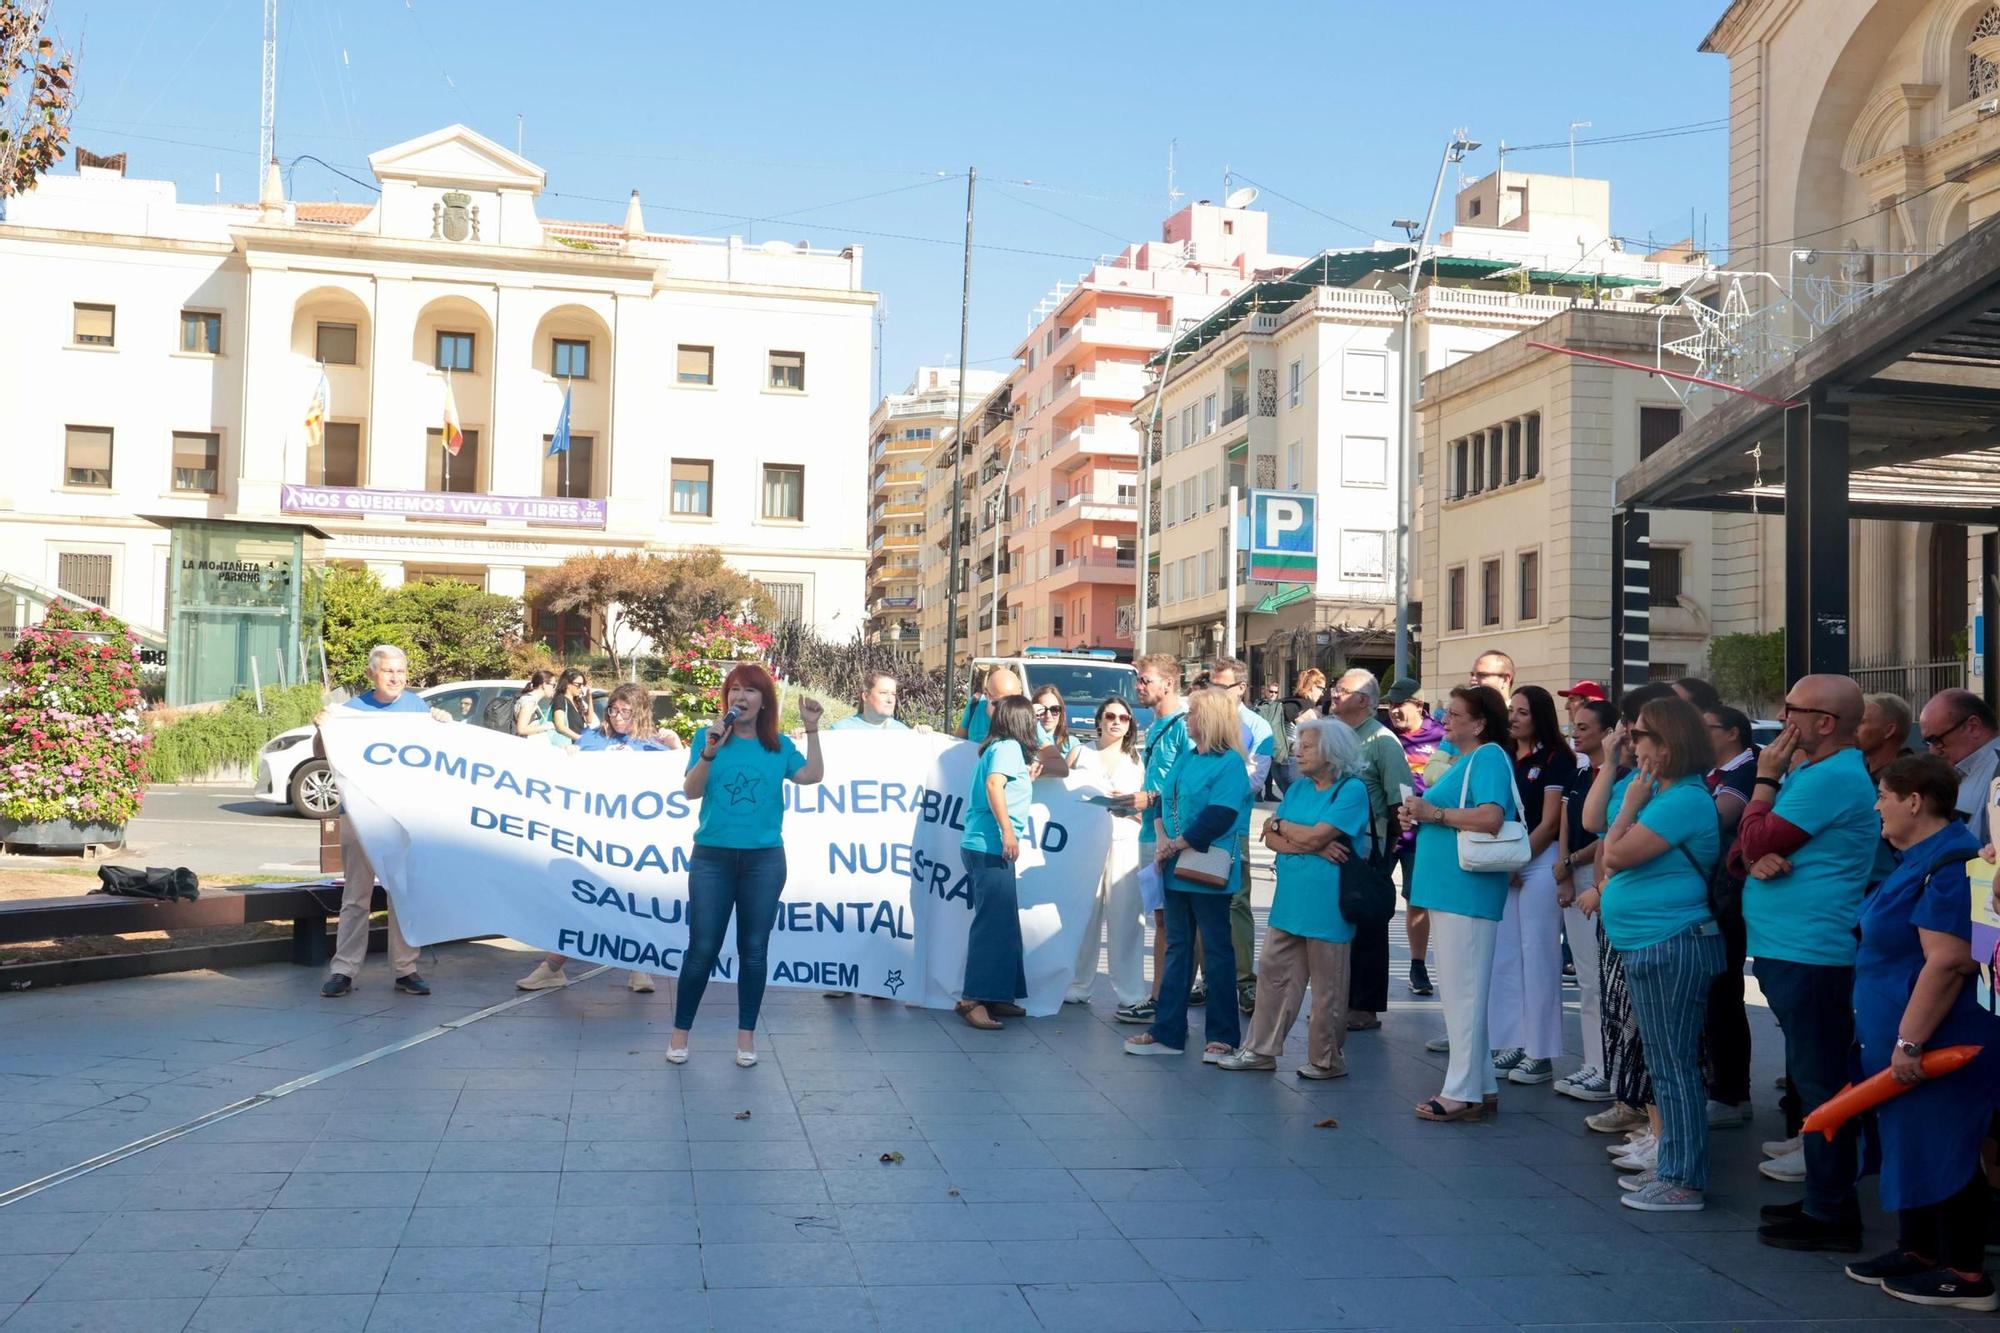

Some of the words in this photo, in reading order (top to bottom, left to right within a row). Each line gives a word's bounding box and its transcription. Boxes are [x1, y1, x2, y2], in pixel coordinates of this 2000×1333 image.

[300, 492, 340, 508] NOS
[344, 493, 446, 513] QUEREMOS
[448, 499, 503, 516] VIVAS
[507, 502, 519, 516] Y
[523, 503, 578, 519] LIBRES
[1265, 498, 1304, 547] P
[182, 559, 195, 570] LA
[198, 559, 260, 572] MONTAÑETA
[218, 571, 261, 583] PARKING
[362, 742, 691, 820] COMPARTIMOS
[470, 806, 690, 875] DEFENDAM
[571, 879, 691, 926] SALU
[558, 928, 732, 979] FUNDACN
[772, 960, 859, 988] ADIEM
